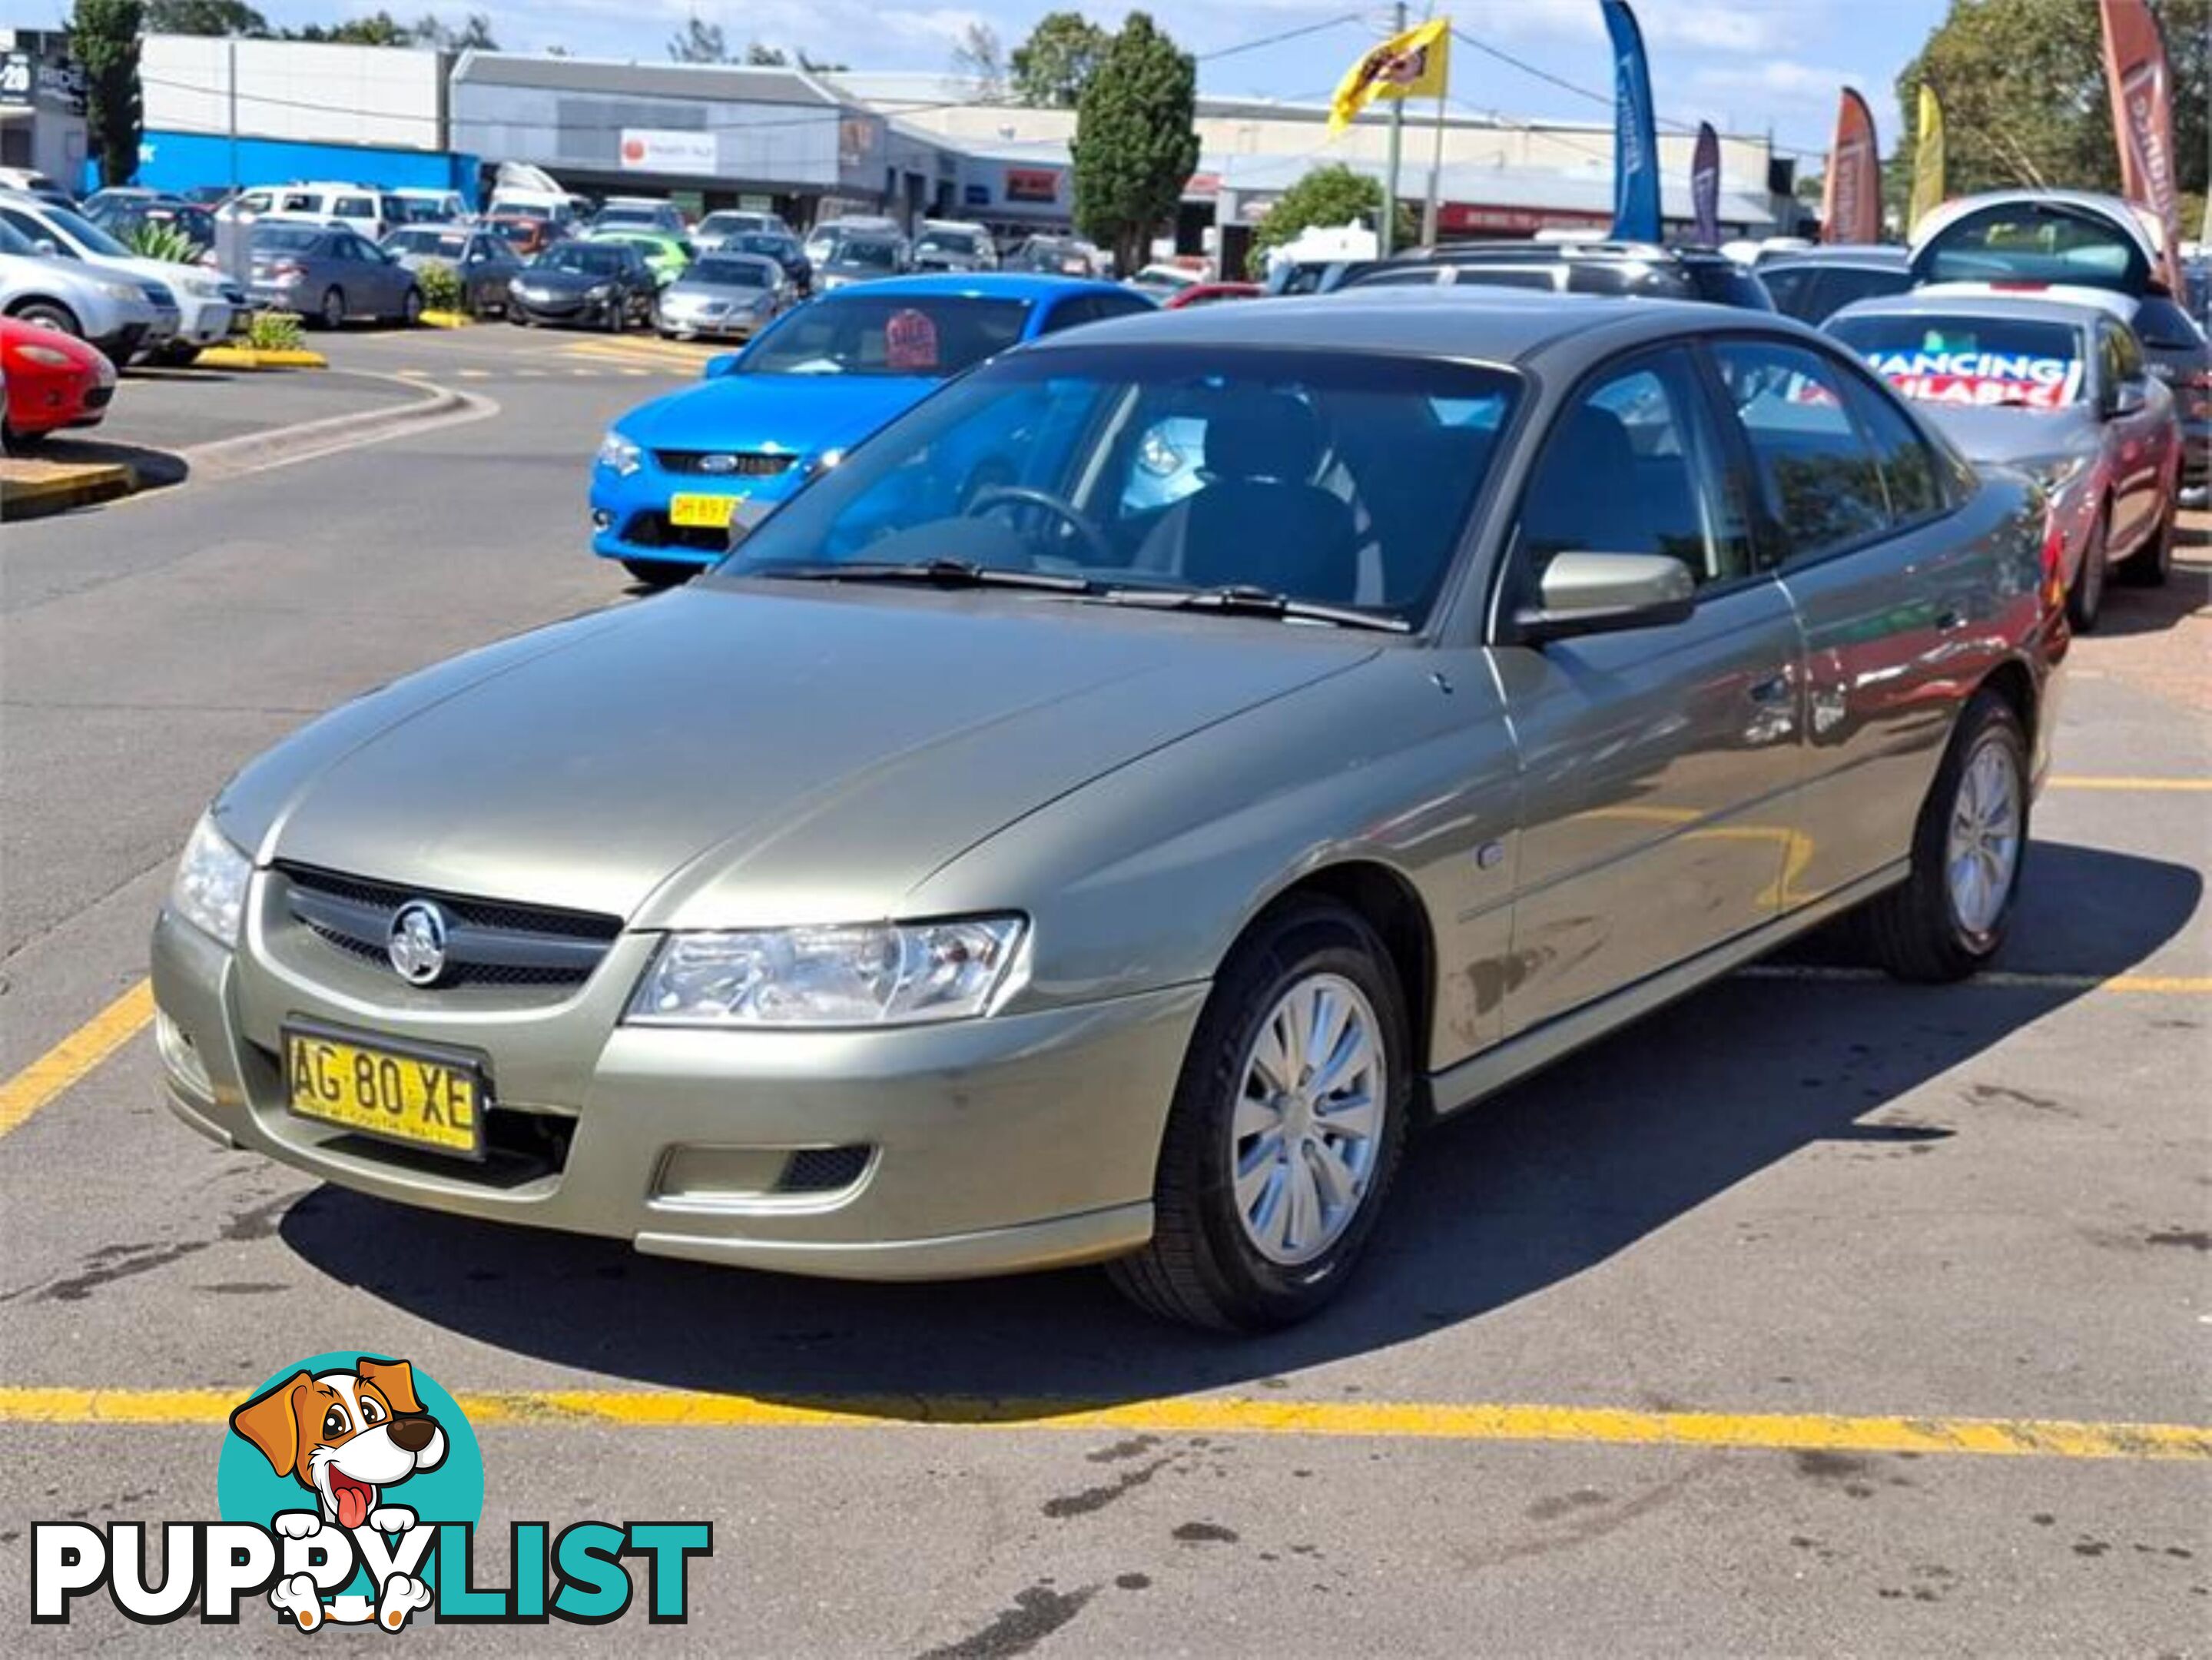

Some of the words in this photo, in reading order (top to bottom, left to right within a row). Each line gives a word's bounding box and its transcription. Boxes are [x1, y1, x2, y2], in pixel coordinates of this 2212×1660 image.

[294, 1038, 340, 1101] AG
[353, 1052, 403, 1115] 80
[419, 1062, 474, 1130] XE
